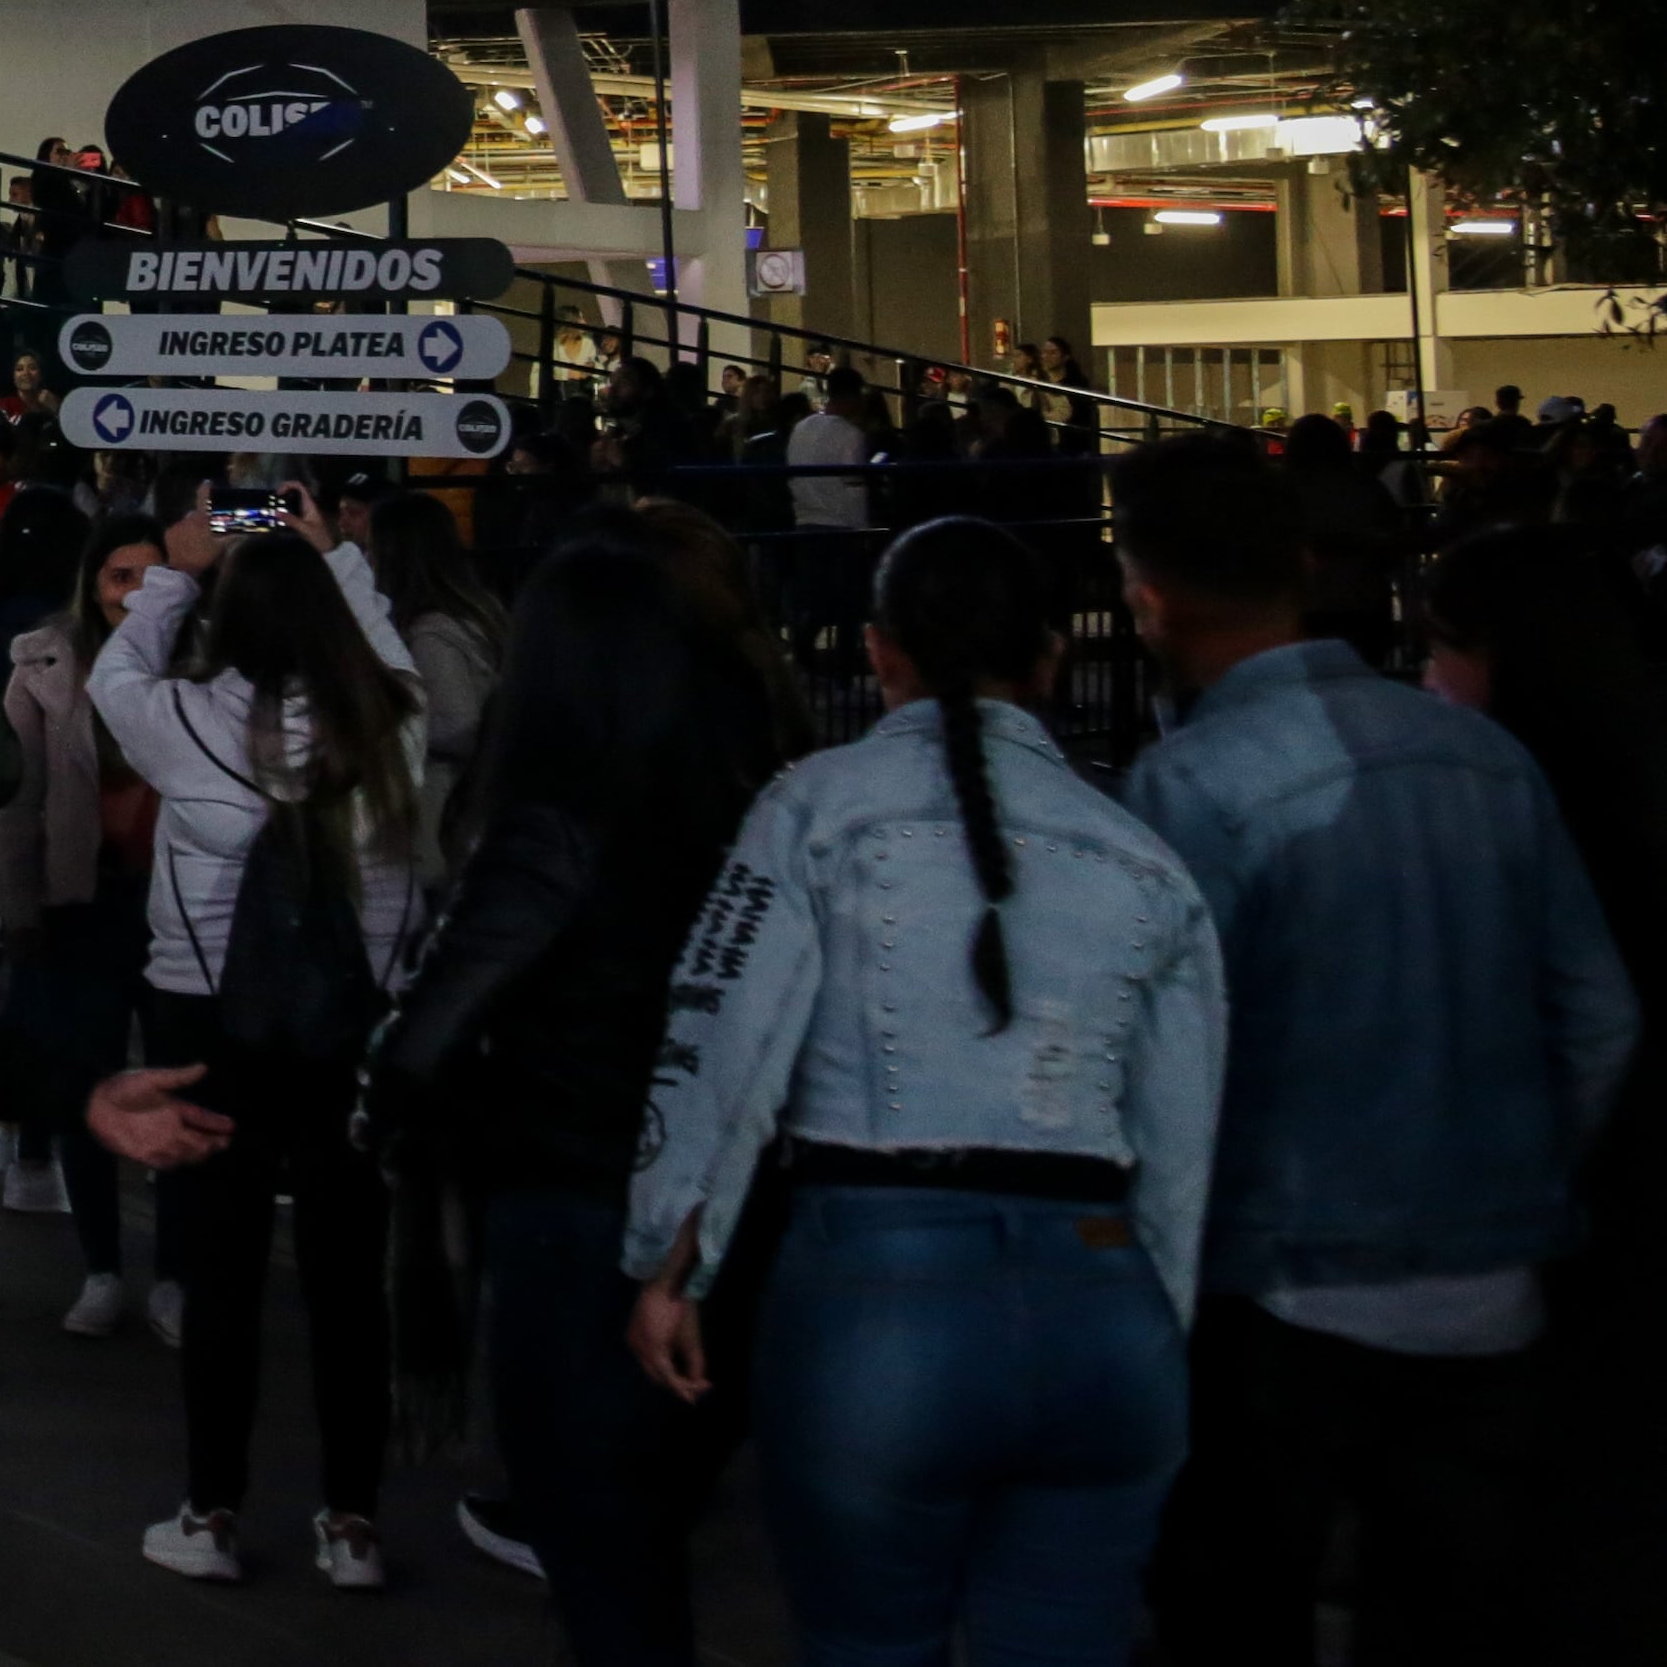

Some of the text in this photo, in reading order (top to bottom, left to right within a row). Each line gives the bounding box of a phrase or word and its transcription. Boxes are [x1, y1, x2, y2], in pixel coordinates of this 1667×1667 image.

[126, 249, 444, 291] BIENVENIDOS
[158, 331, 404, 357] INGRESO PLATEA
[140, 408, 423, 441] INGRESO GRADERÍA
